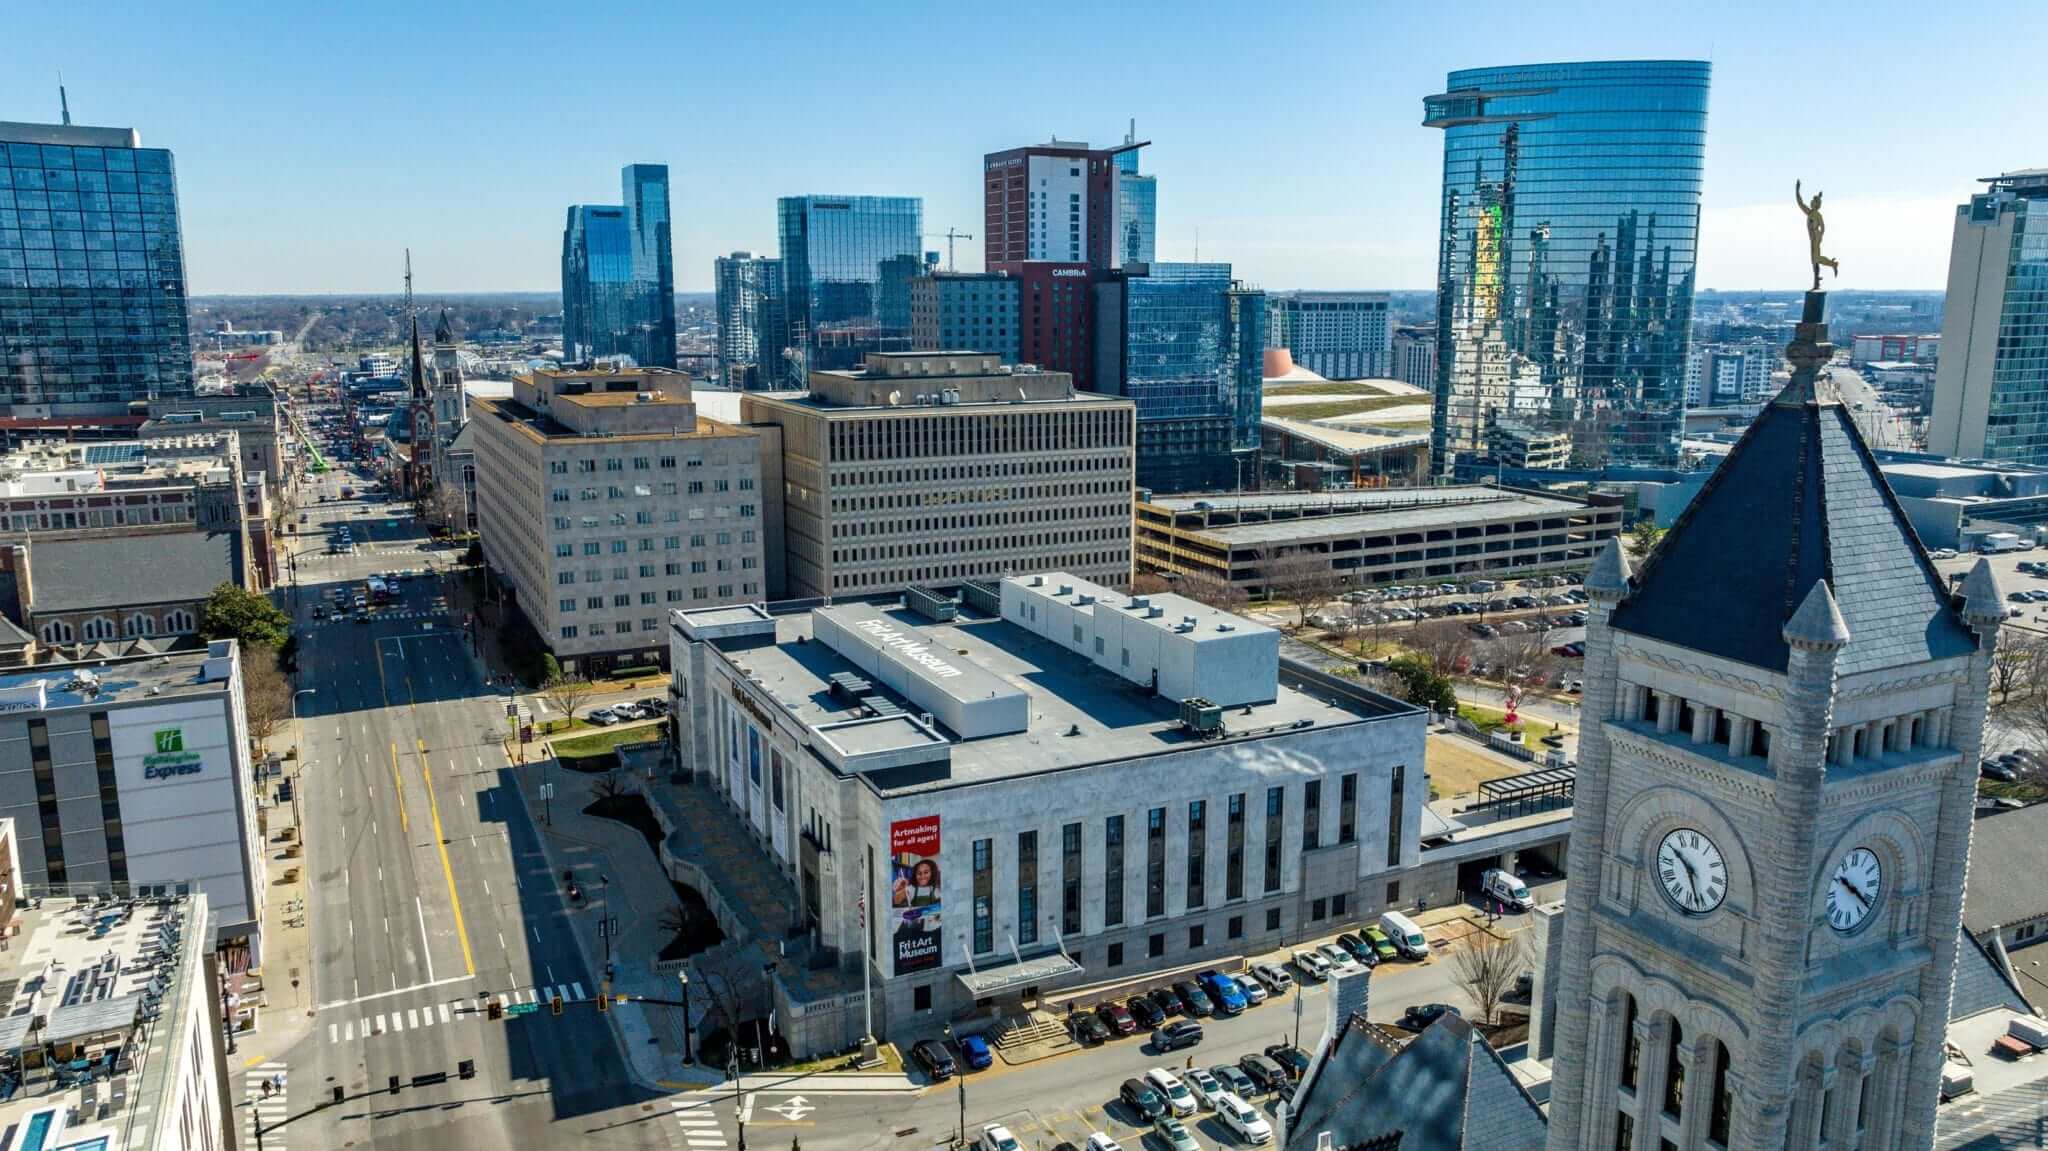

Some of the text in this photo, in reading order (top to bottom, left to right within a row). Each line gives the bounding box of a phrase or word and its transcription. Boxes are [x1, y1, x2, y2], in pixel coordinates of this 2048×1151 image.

[894, 641, 963, 678] Museum
[144, 762, 202, 780] Express
[893, 824, 938, 838] Artmaking
[899, 936, 932, 951] Frit Art
[899, 944, 938, 960] Museum
